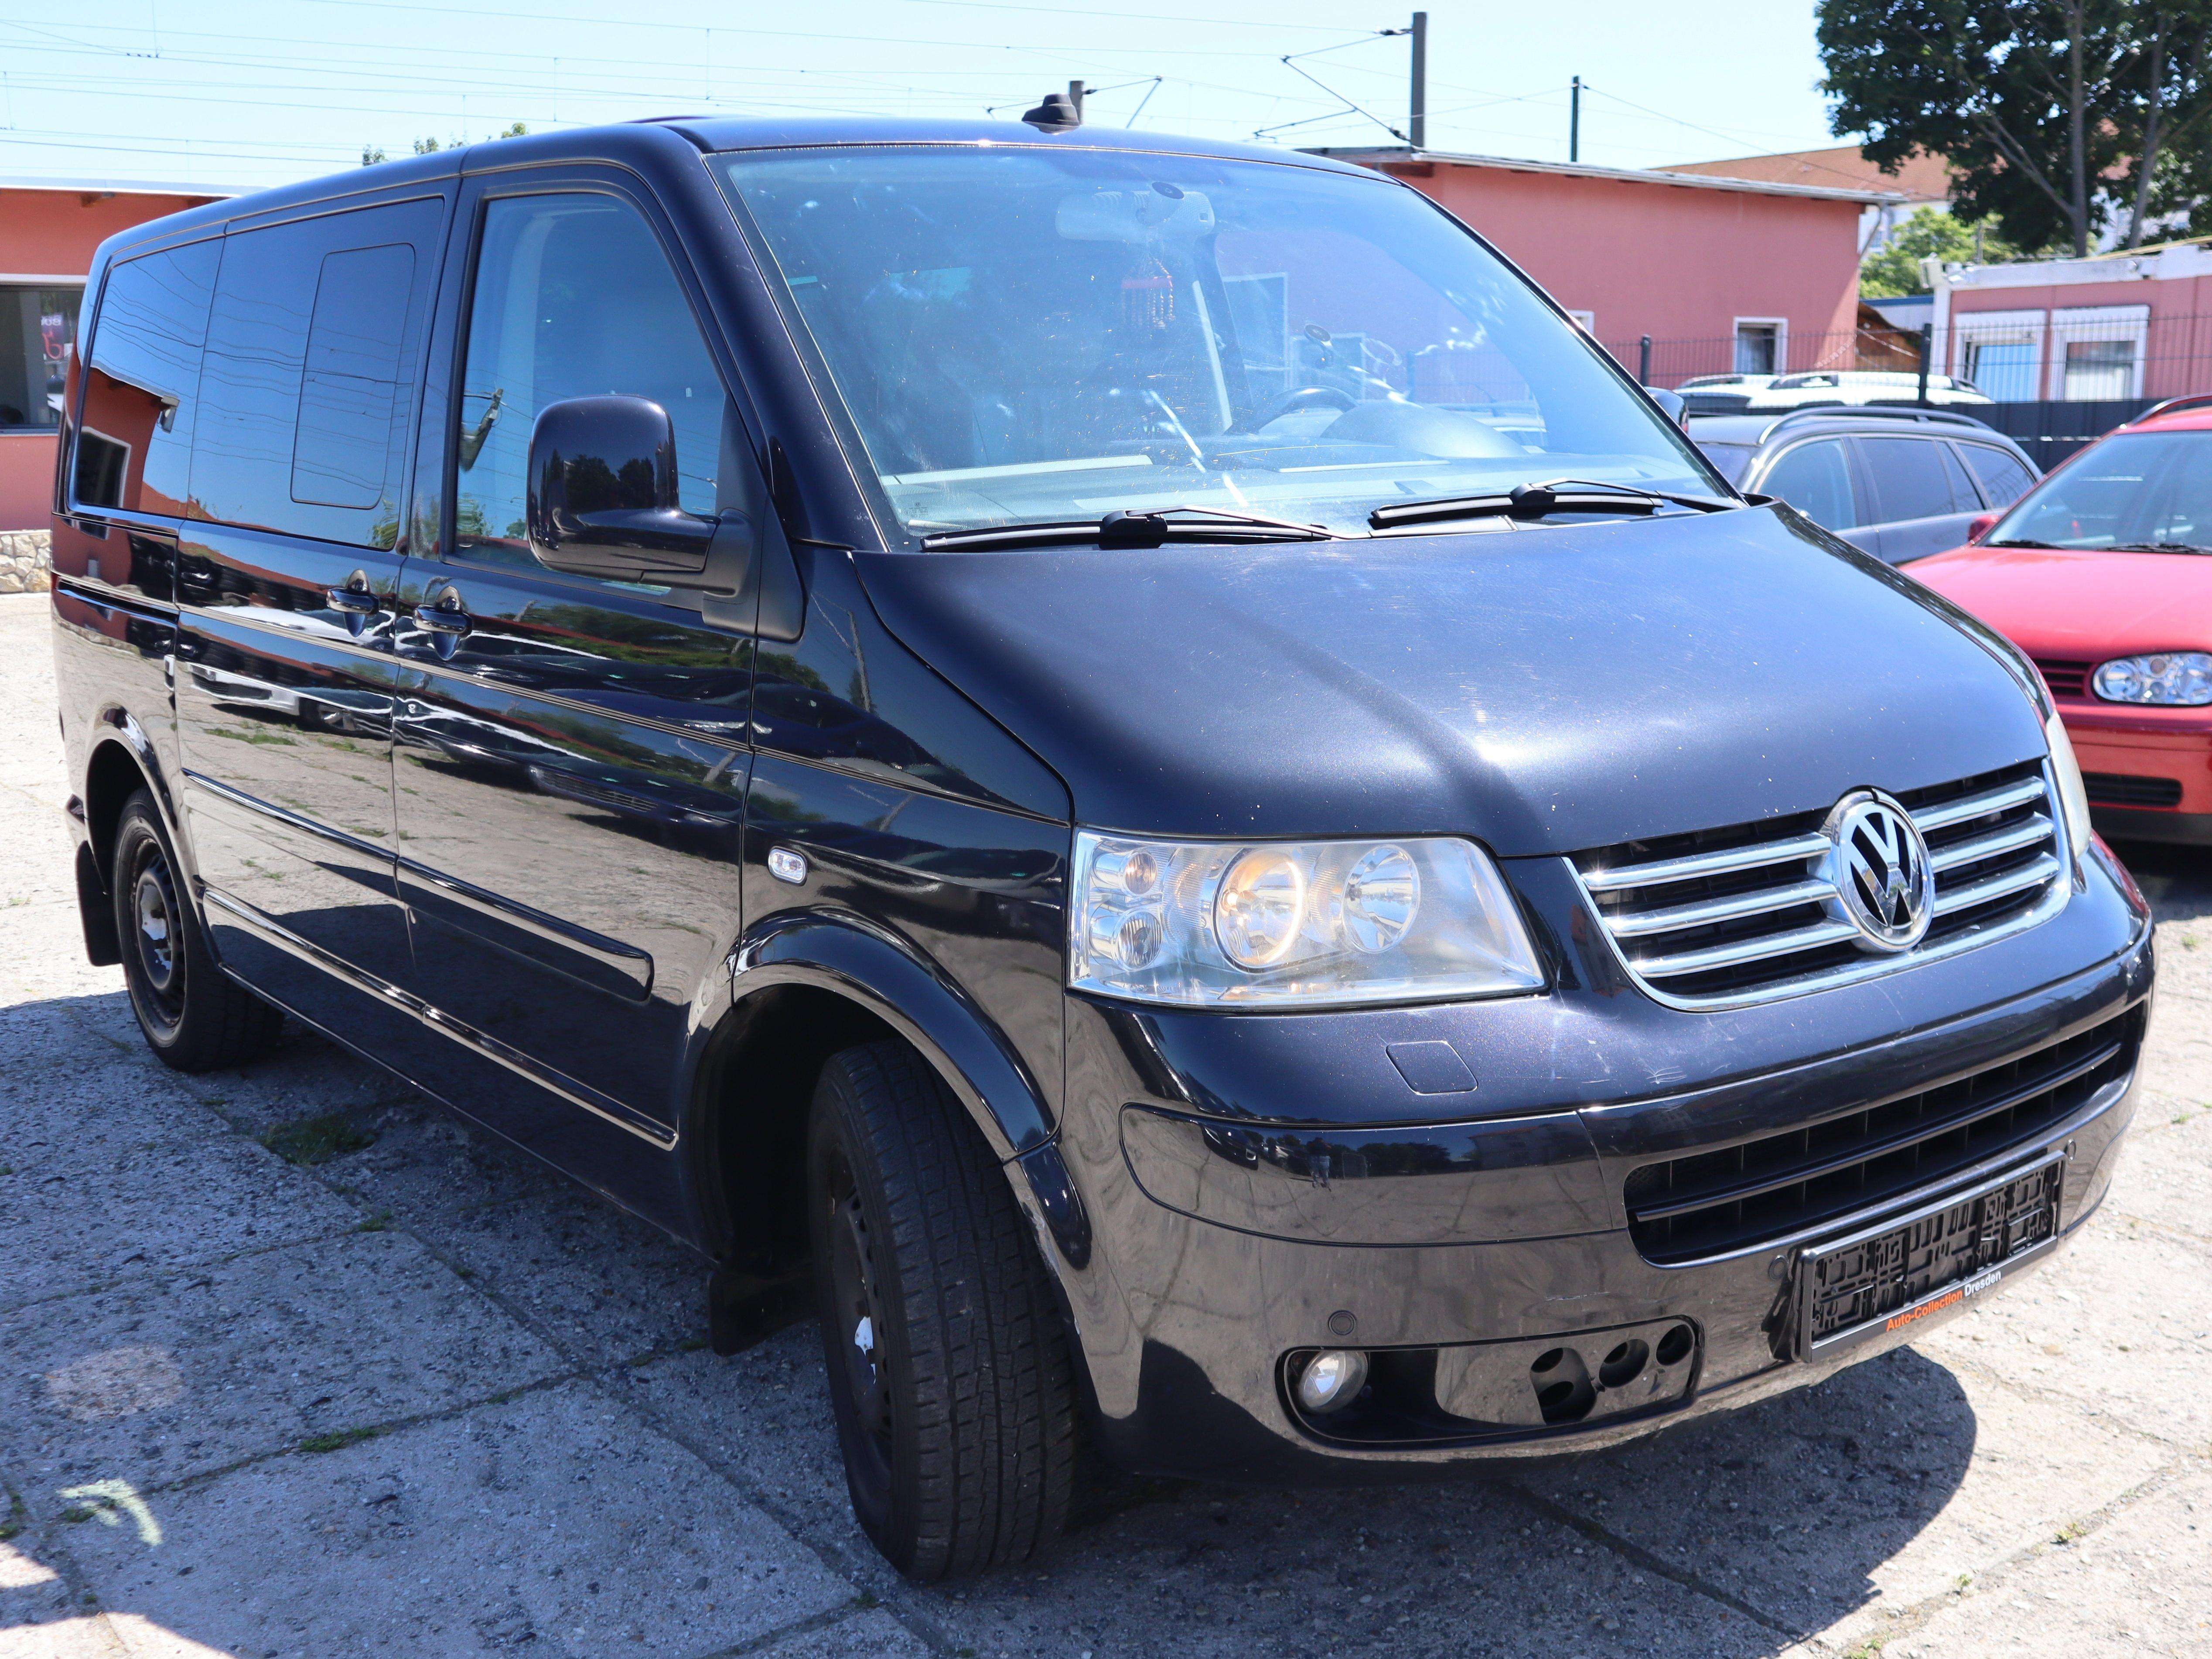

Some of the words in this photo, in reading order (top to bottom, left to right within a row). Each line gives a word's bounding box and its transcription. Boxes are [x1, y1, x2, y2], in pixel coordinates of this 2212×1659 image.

[1841, 802, 1928, 944] VW
[1886, 1290, 1963, 1332] Auto-Collection
[1964, 1270, 2002, 1297] Dresden
